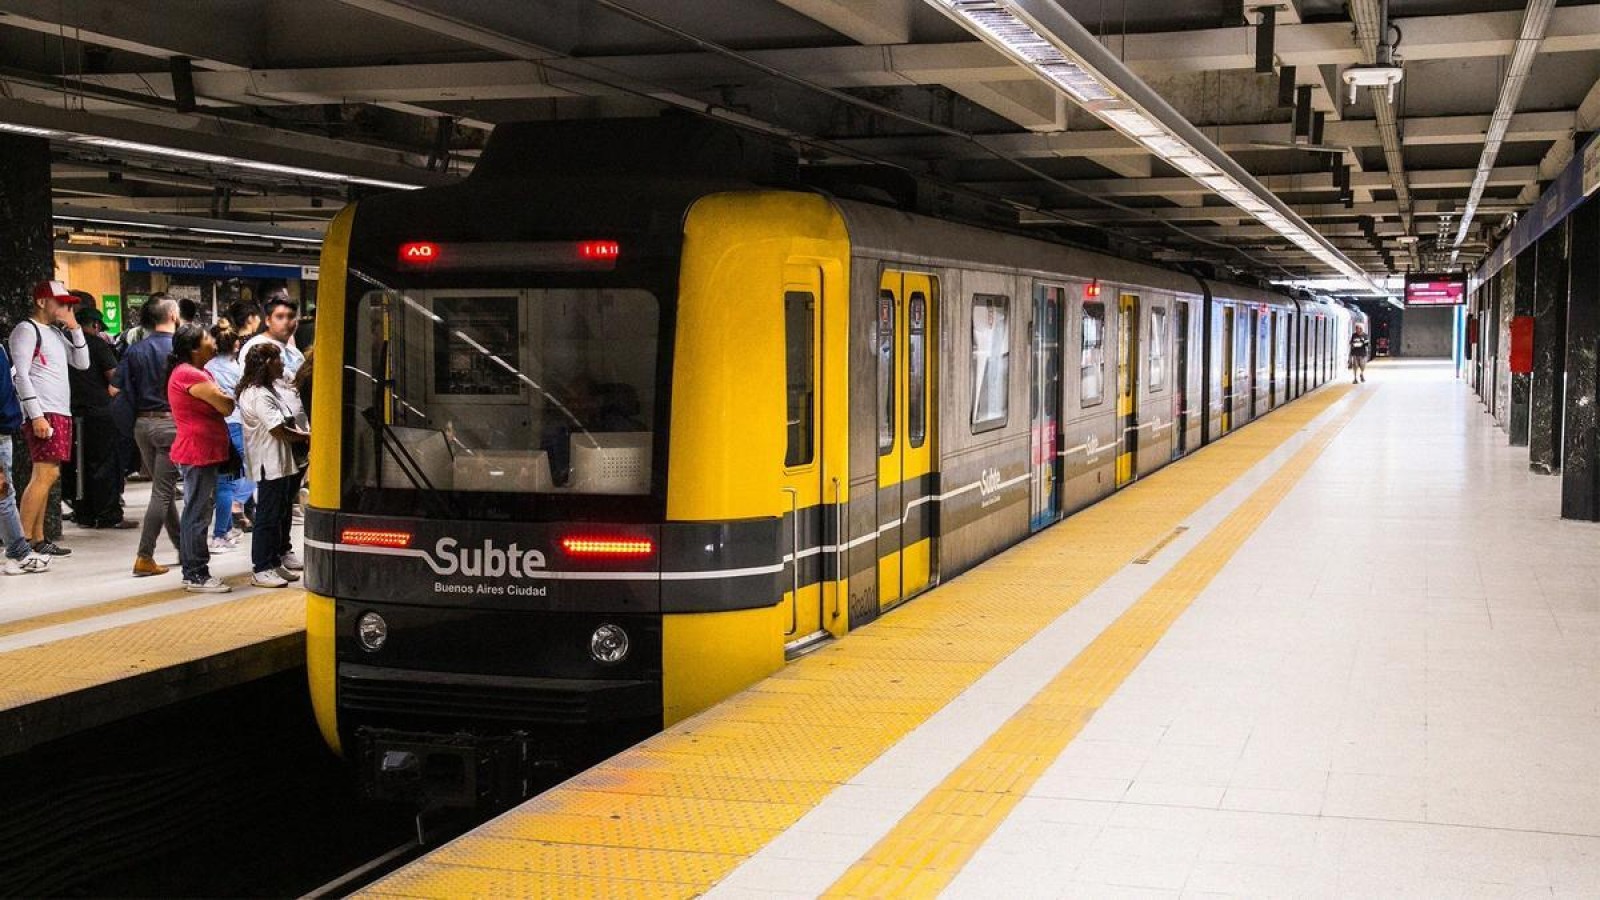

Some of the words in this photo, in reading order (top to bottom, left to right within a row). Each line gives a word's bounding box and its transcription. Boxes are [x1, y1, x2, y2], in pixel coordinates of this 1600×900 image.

[981, 467, 1001, 496] Subte
[435, 537, 546, 579] Subte
[434, 582, 474, 594] Buenos
[476, 583, 504, 595] Aires
[507, 584, 547, 597] Ciudad
